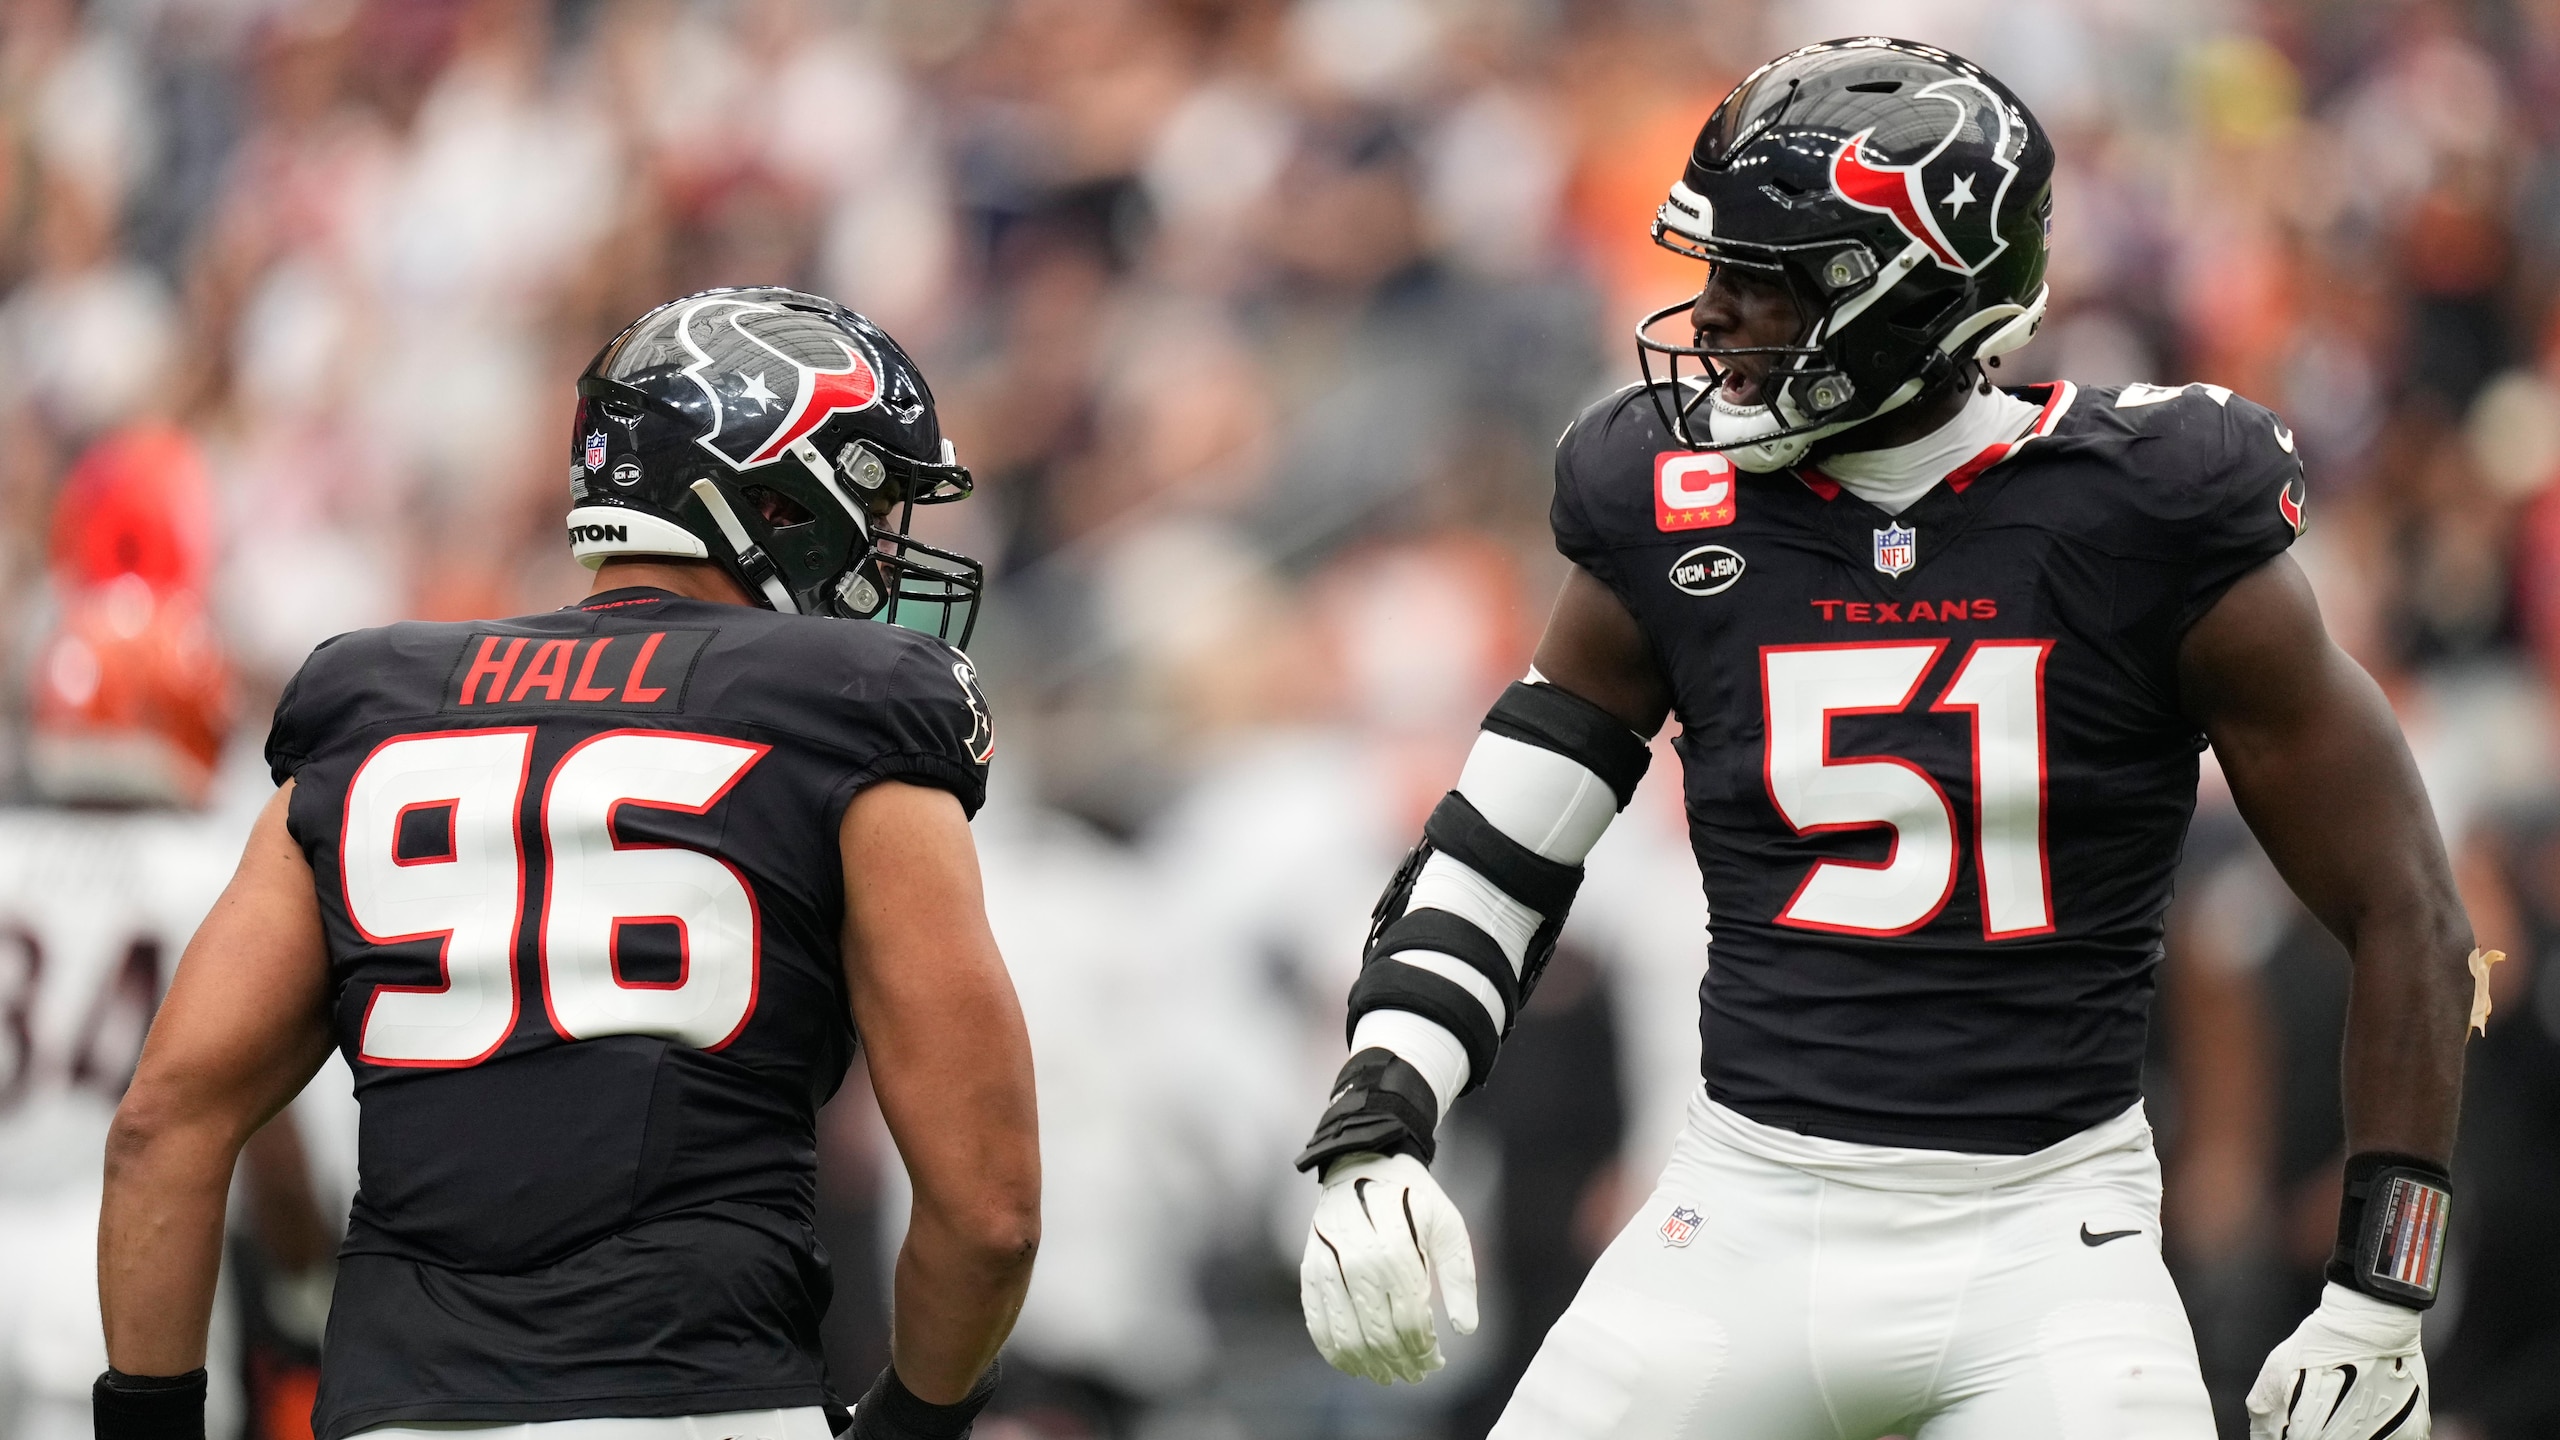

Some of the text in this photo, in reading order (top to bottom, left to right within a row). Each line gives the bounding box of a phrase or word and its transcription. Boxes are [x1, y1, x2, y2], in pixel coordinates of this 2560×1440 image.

[588, 448, 604, 466] NFL
[1661, 453, 1729, 510] C
[1881, 547, 1910, 568] NFL
[1811, 599, 1998, 624] TEXANS
[458, 632, 667, 705] HALL
[1758, 638, 2057, 942] 51
[338, 725, 774, 1068] 96
[1663, 1218, 1690, 1241] NFL
